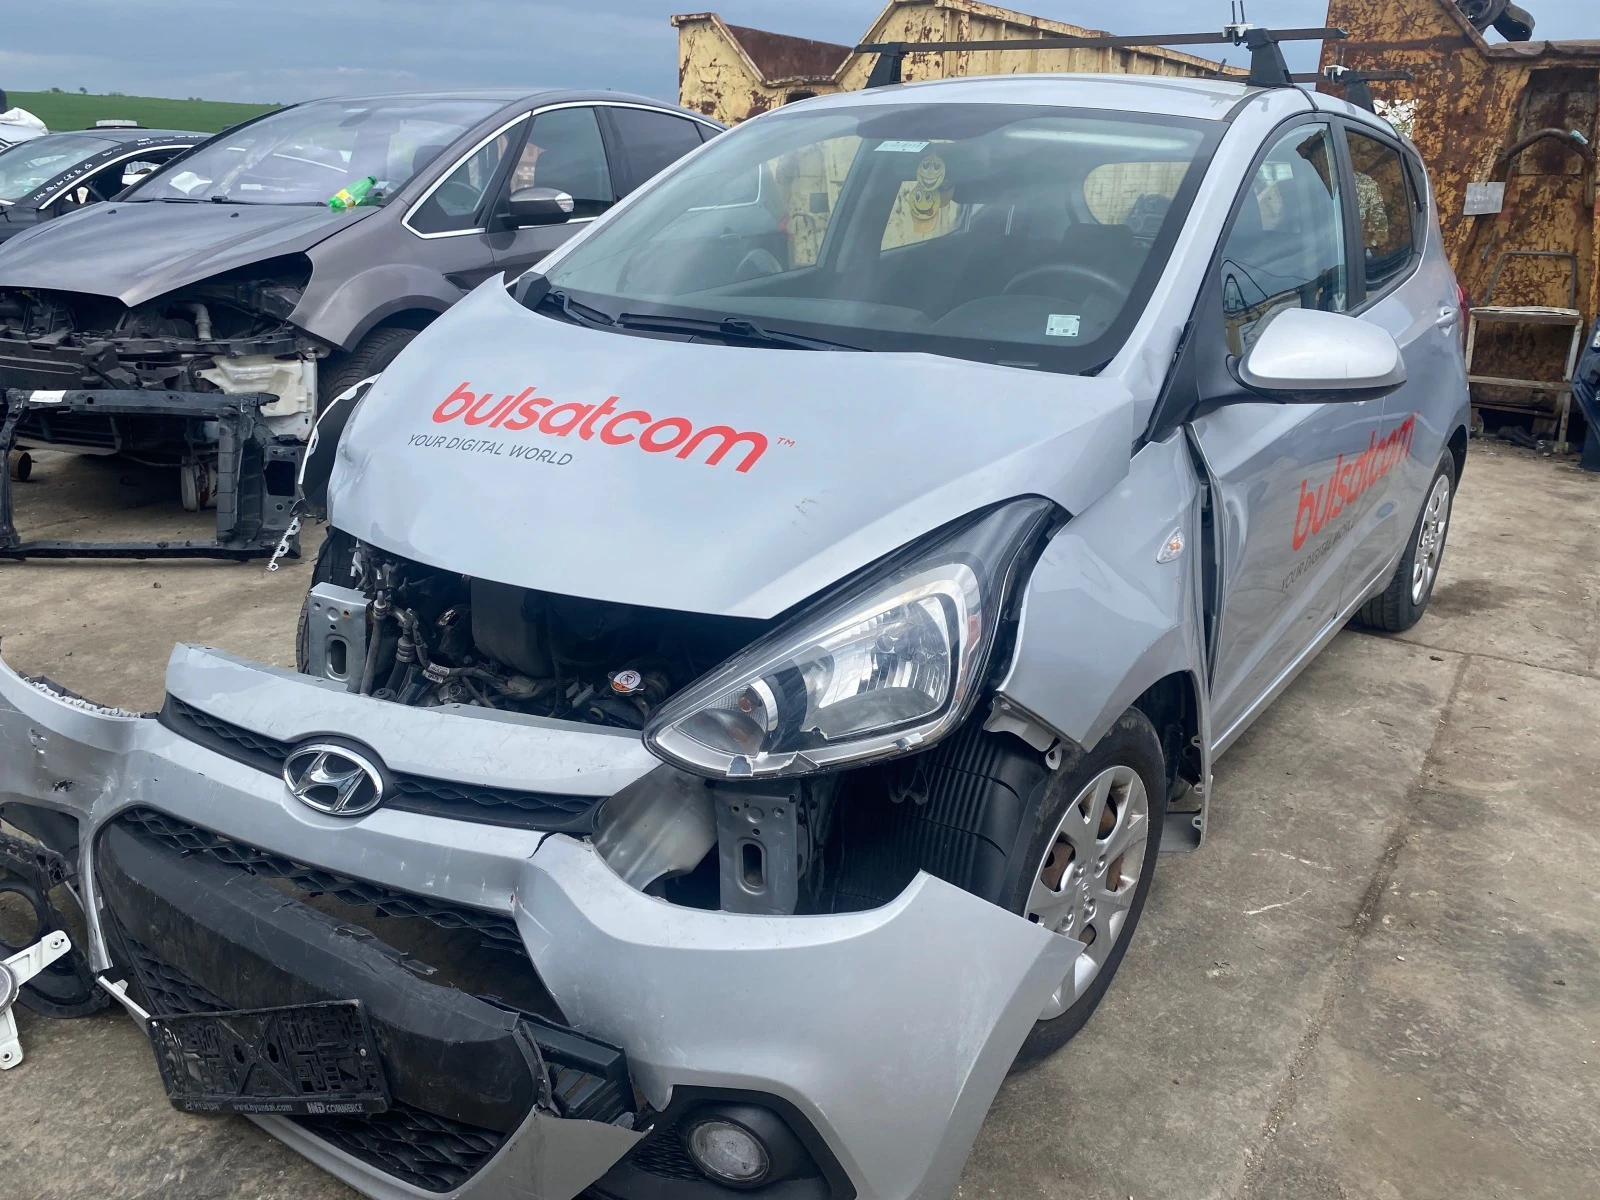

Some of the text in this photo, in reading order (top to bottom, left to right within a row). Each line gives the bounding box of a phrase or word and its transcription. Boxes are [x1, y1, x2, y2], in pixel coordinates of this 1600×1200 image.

[407, 433, 573, 467] YOUR DIGITAL WORLD
[432, 382, 769, 474] bulsatcom
[1292, 414, 1416, 552] bulsatcom
